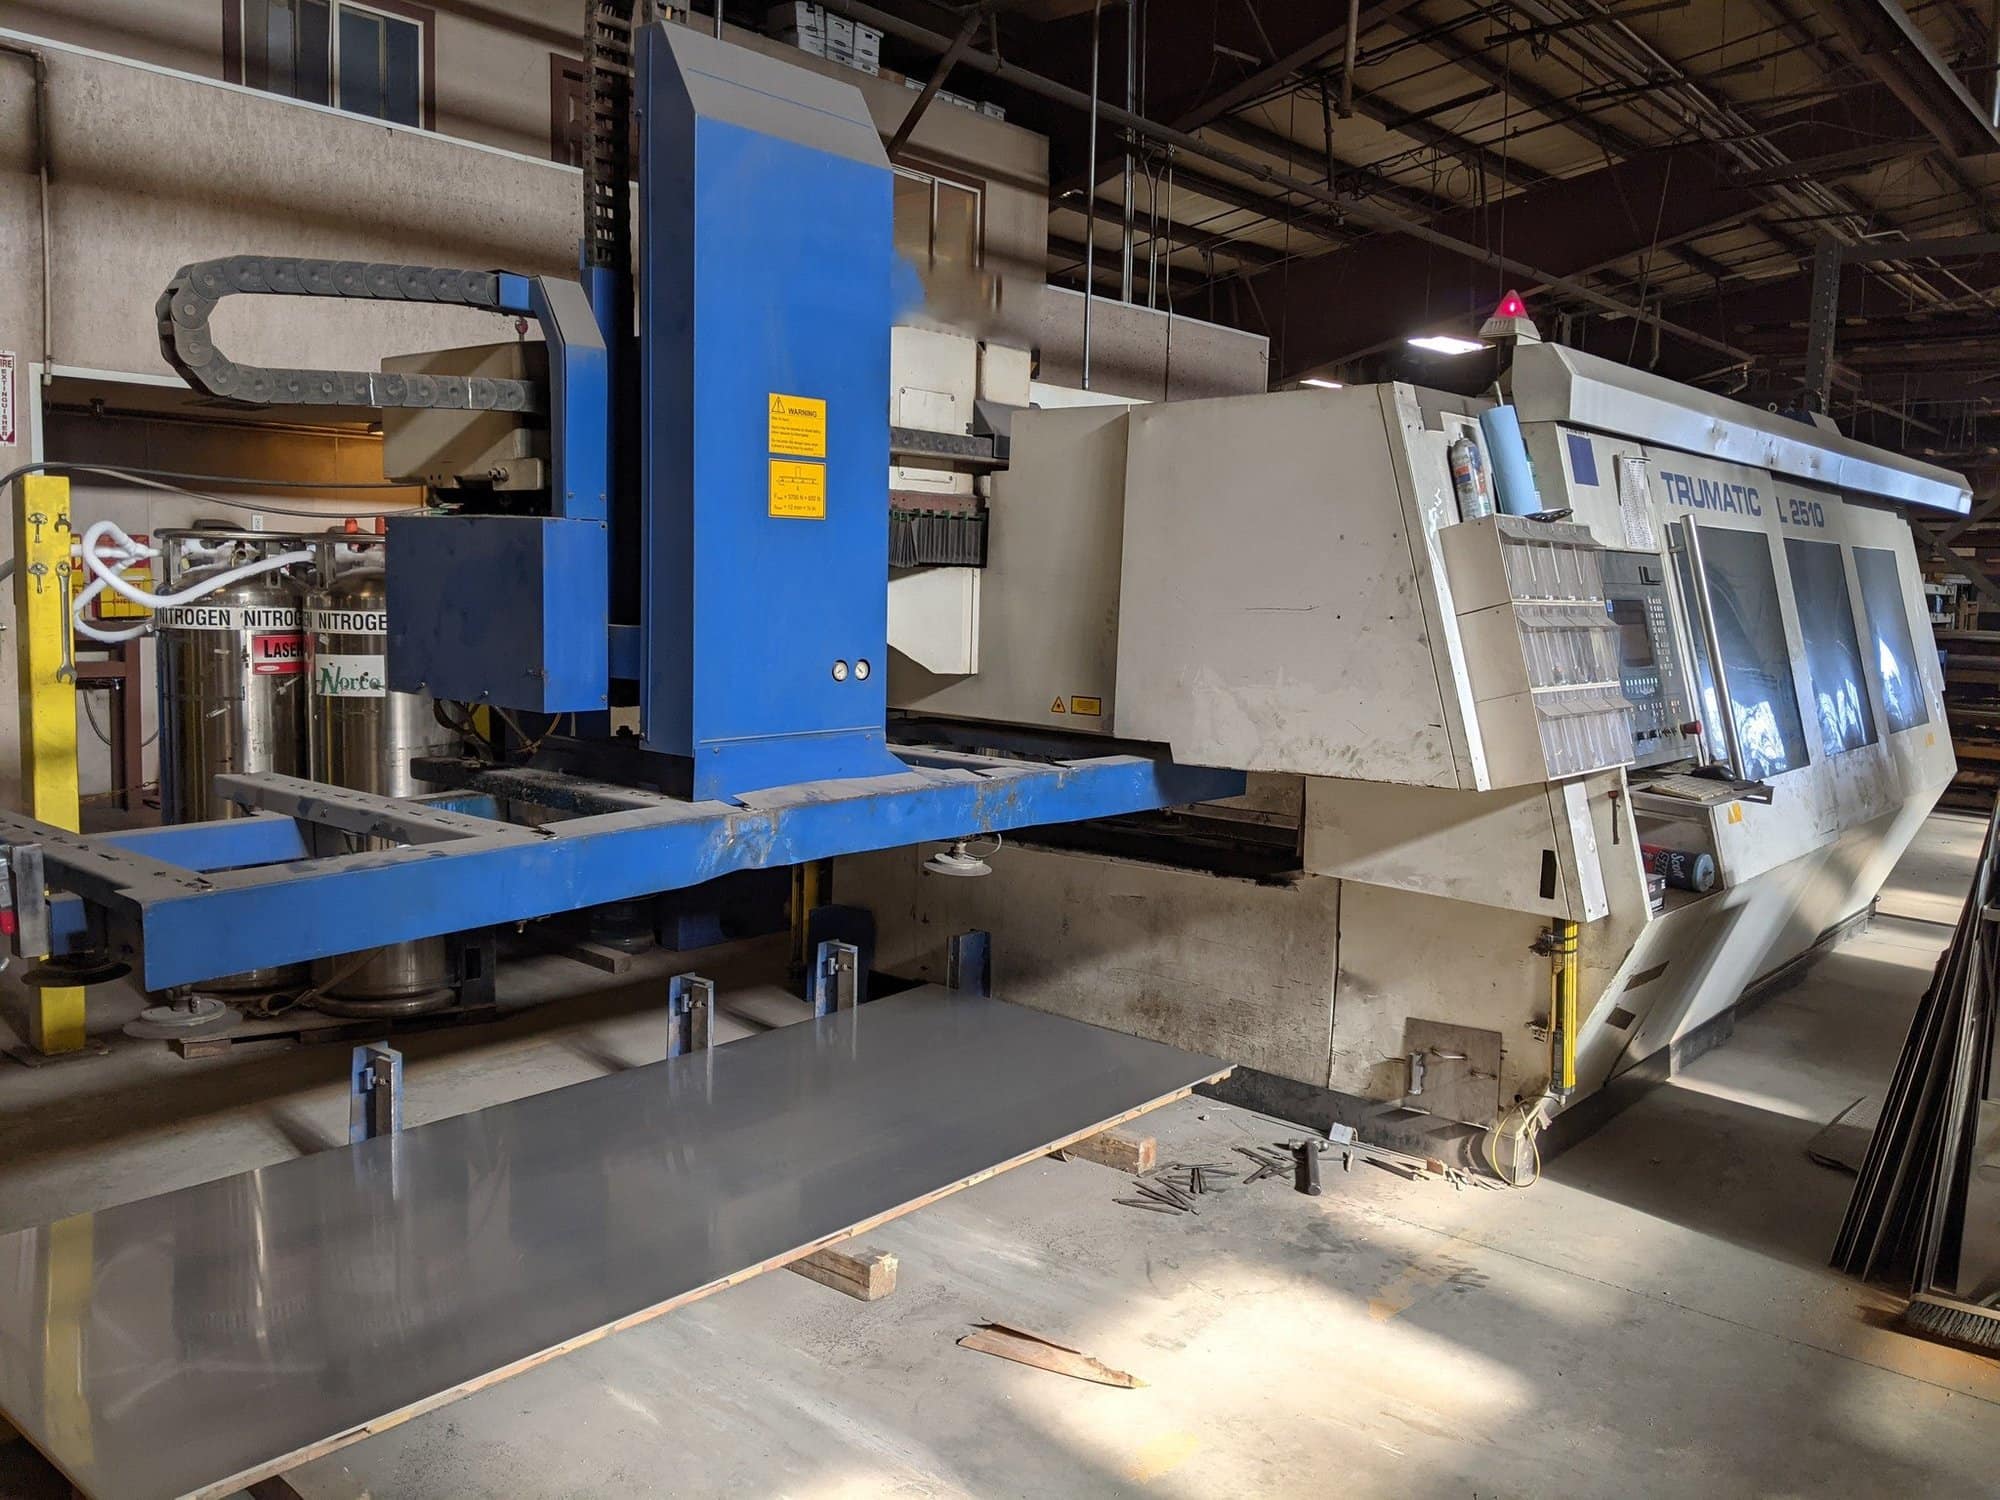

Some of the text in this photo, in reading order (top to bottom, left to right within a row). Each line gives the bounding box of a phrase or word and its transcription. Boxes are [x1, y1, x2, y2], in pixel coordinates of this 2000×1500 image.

[0, 359, 12, 368] IRE
[787, 407, 817, 418] WARNING
[1660, 471, 1825, 528] TRUMATIC L 2510
[159, 607, 231, 626] NITROGEN
[244, 609, 303, 627] NITROG
[318, 612, 388, 631] NITROGE
[1671, 853, 1685, 878] Scott
